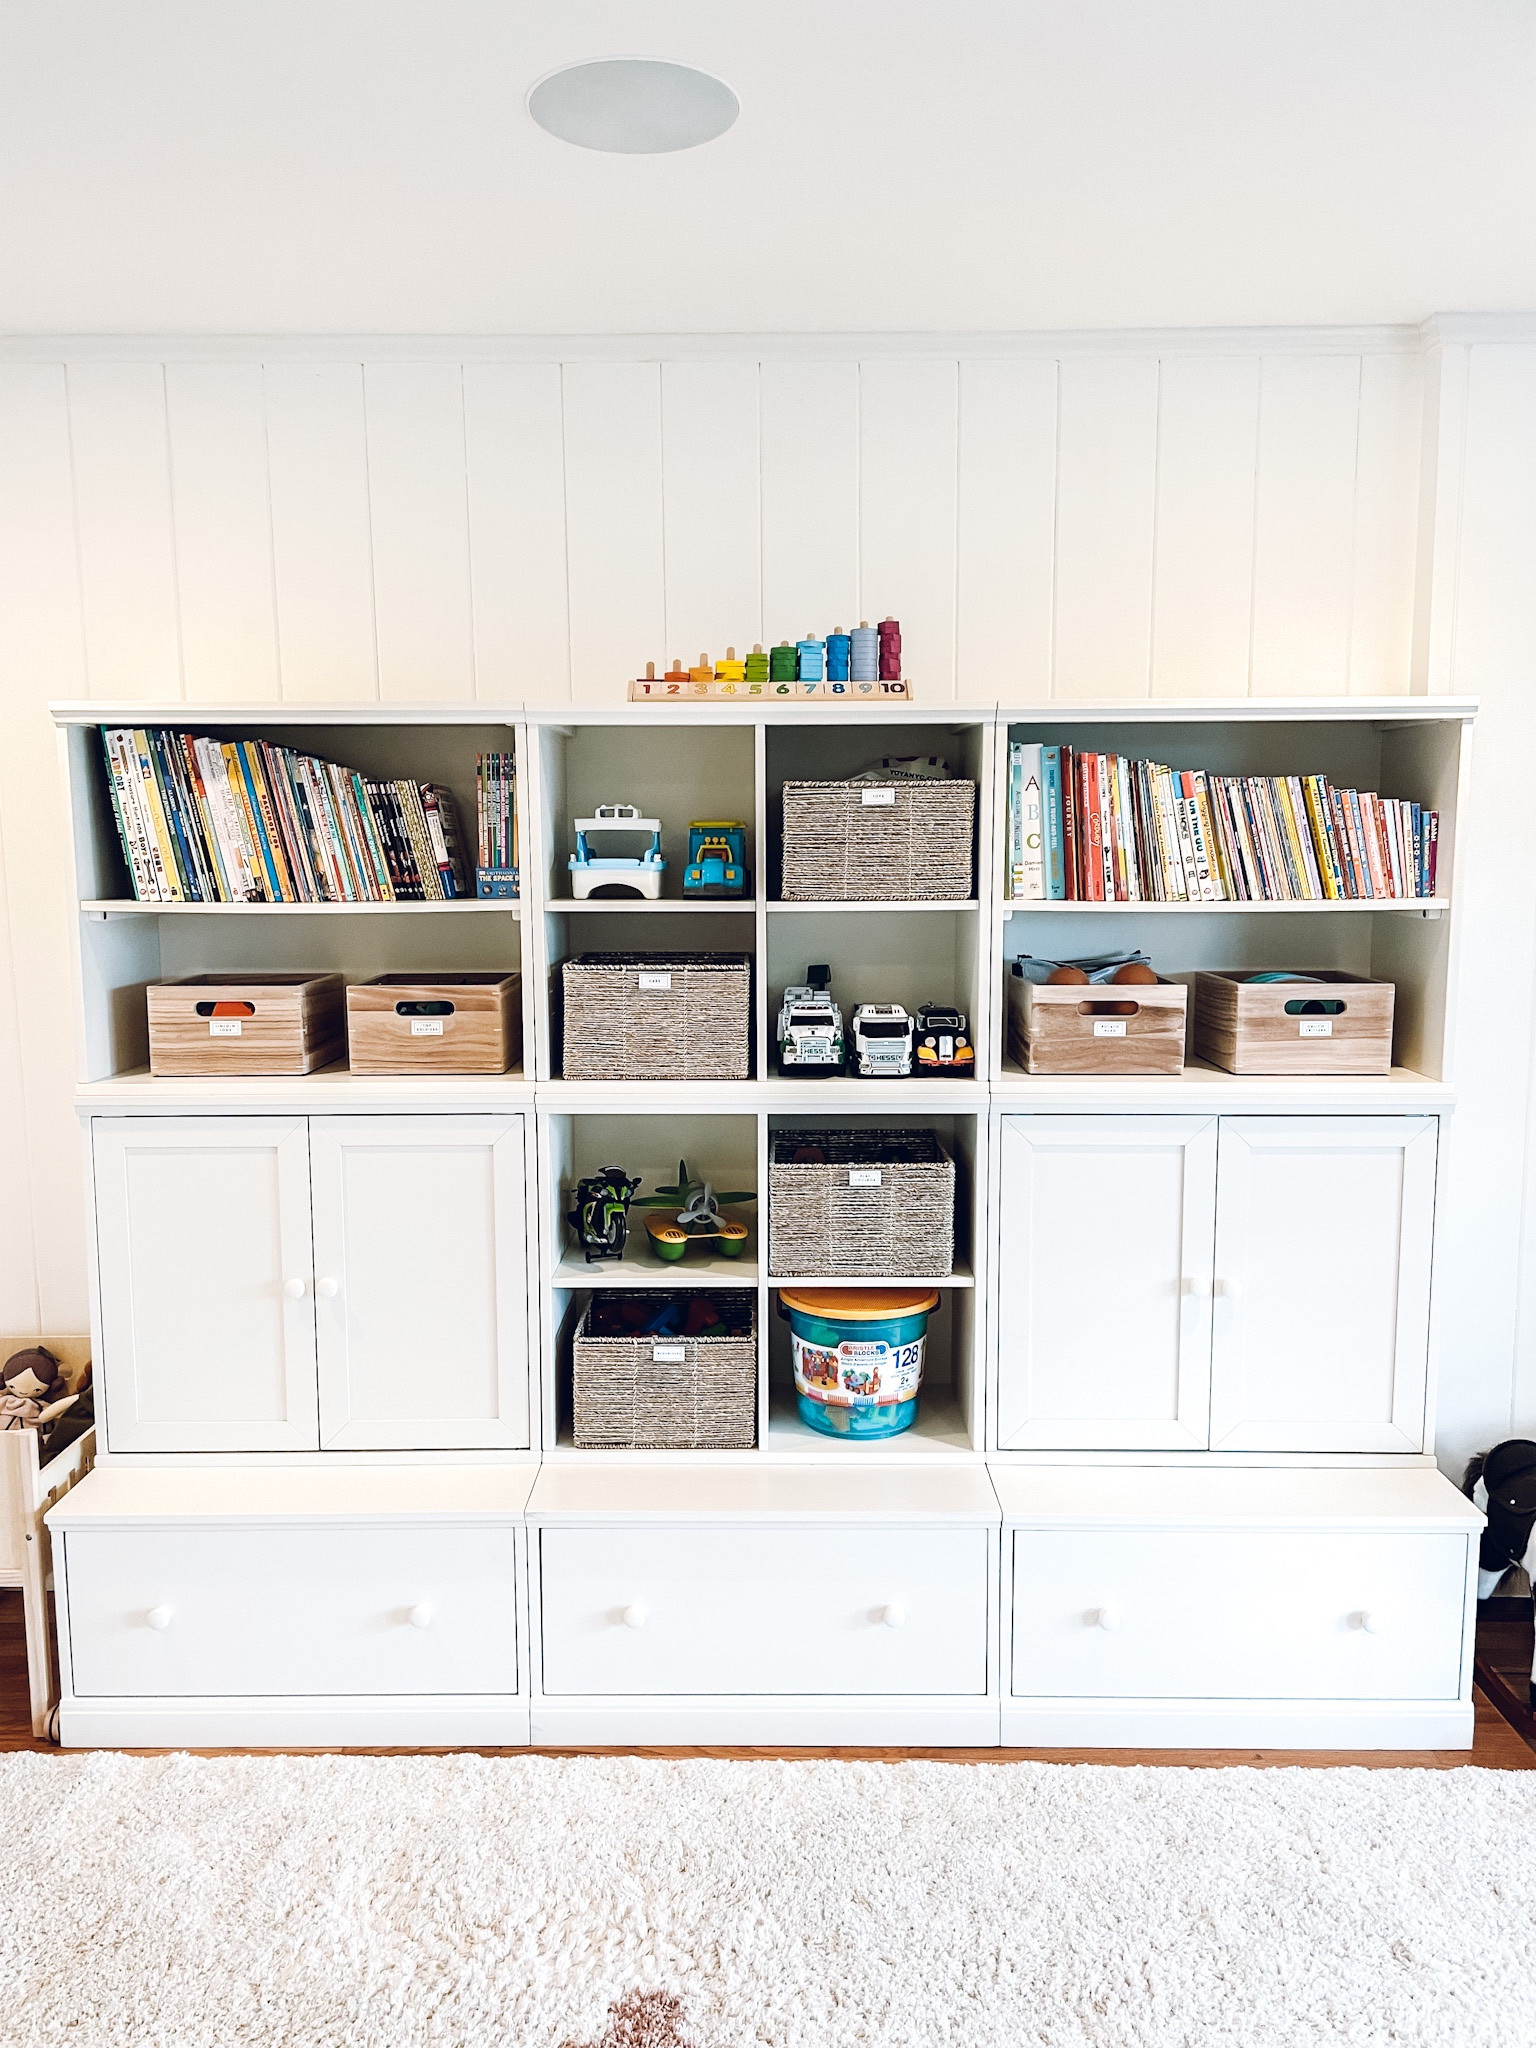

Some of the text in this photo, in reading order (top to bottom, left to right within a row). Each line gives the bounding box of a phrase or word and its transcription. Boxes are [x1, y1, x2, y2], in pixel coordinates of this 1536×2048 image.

[643, 683, 905, 694] 1 2 3 4 5 6 7 8 9 10
[110, 756, 126, 792] AIRPORT
[1026, 776, 1040, 791] A
[126, 778, 137, 804] Treasure
[132, 806, 140, 820] Hunt
[167, 789, 177, 811] ALADDIN
[1312, 788, 1320, 806] HAPPY
[261, 794, 275, 832] BACKHOE
[1028, 804, 1040, 820] B
[1065, 796, 1073, 837] JOURNEY
[1177, 801, 1189, 840] TRUCKS
[1199, 800, 1211, 827] Digging
[362, 816, 373, 839] CONSENT
[1089, 812, 1101, 847] CORDUROY
[1189, 800, 1203, 852] ON THE GO
[1026, 833, 1041, 849] C
[893, 1344, 918, 1368] 128
